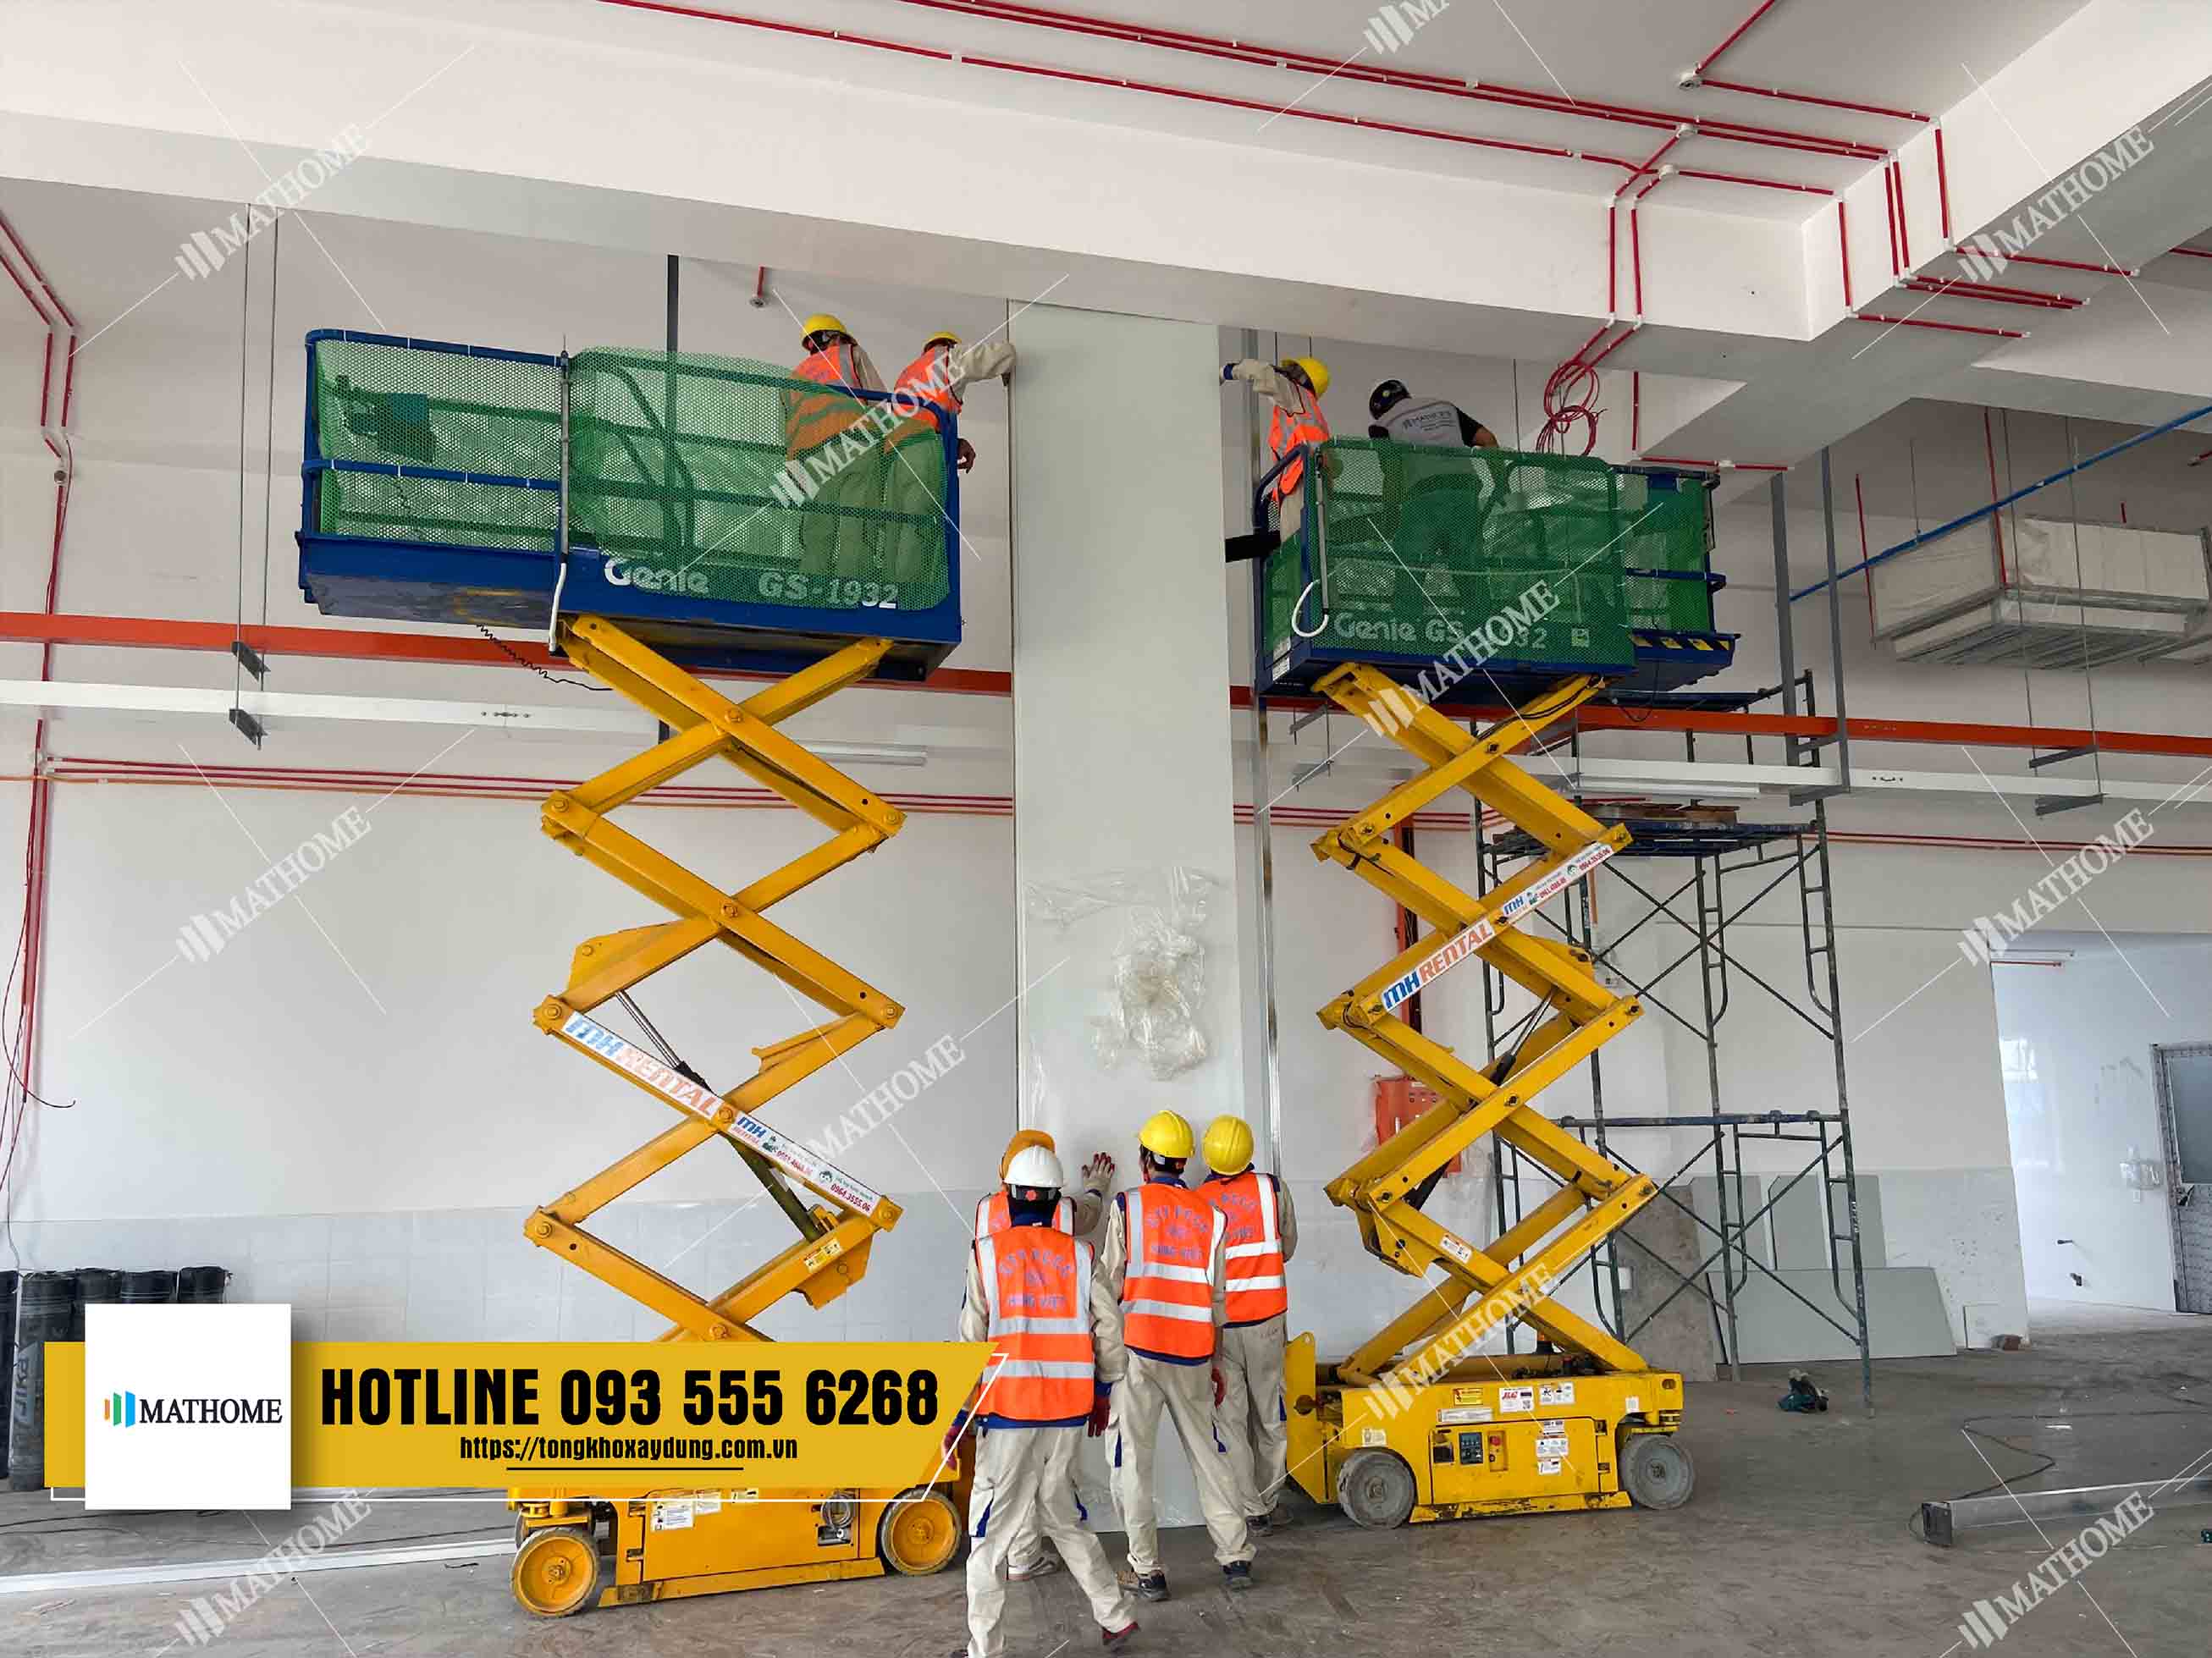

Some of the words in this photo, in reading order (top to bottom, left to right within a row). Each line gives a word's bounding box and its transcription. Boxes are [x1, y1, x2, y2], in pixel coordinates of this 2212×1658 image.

[604, 557, 709, 594] Genie
[758, 570, 899, 609] GS-1932
[1332, 612, 1418, 642] Genie
[1503, 896, 1525, 915] MH
[1383, 971, 1420, 1009] MH
[1418, 923, 1493, 984] RENTAL
[565, 1019, 624, 1058] MH
[615, 1046, 718, 1115] RENTAL
[736, 1116, 767, 1138] MH
[830, 1183, 872, 1213] 0964.3555.06
